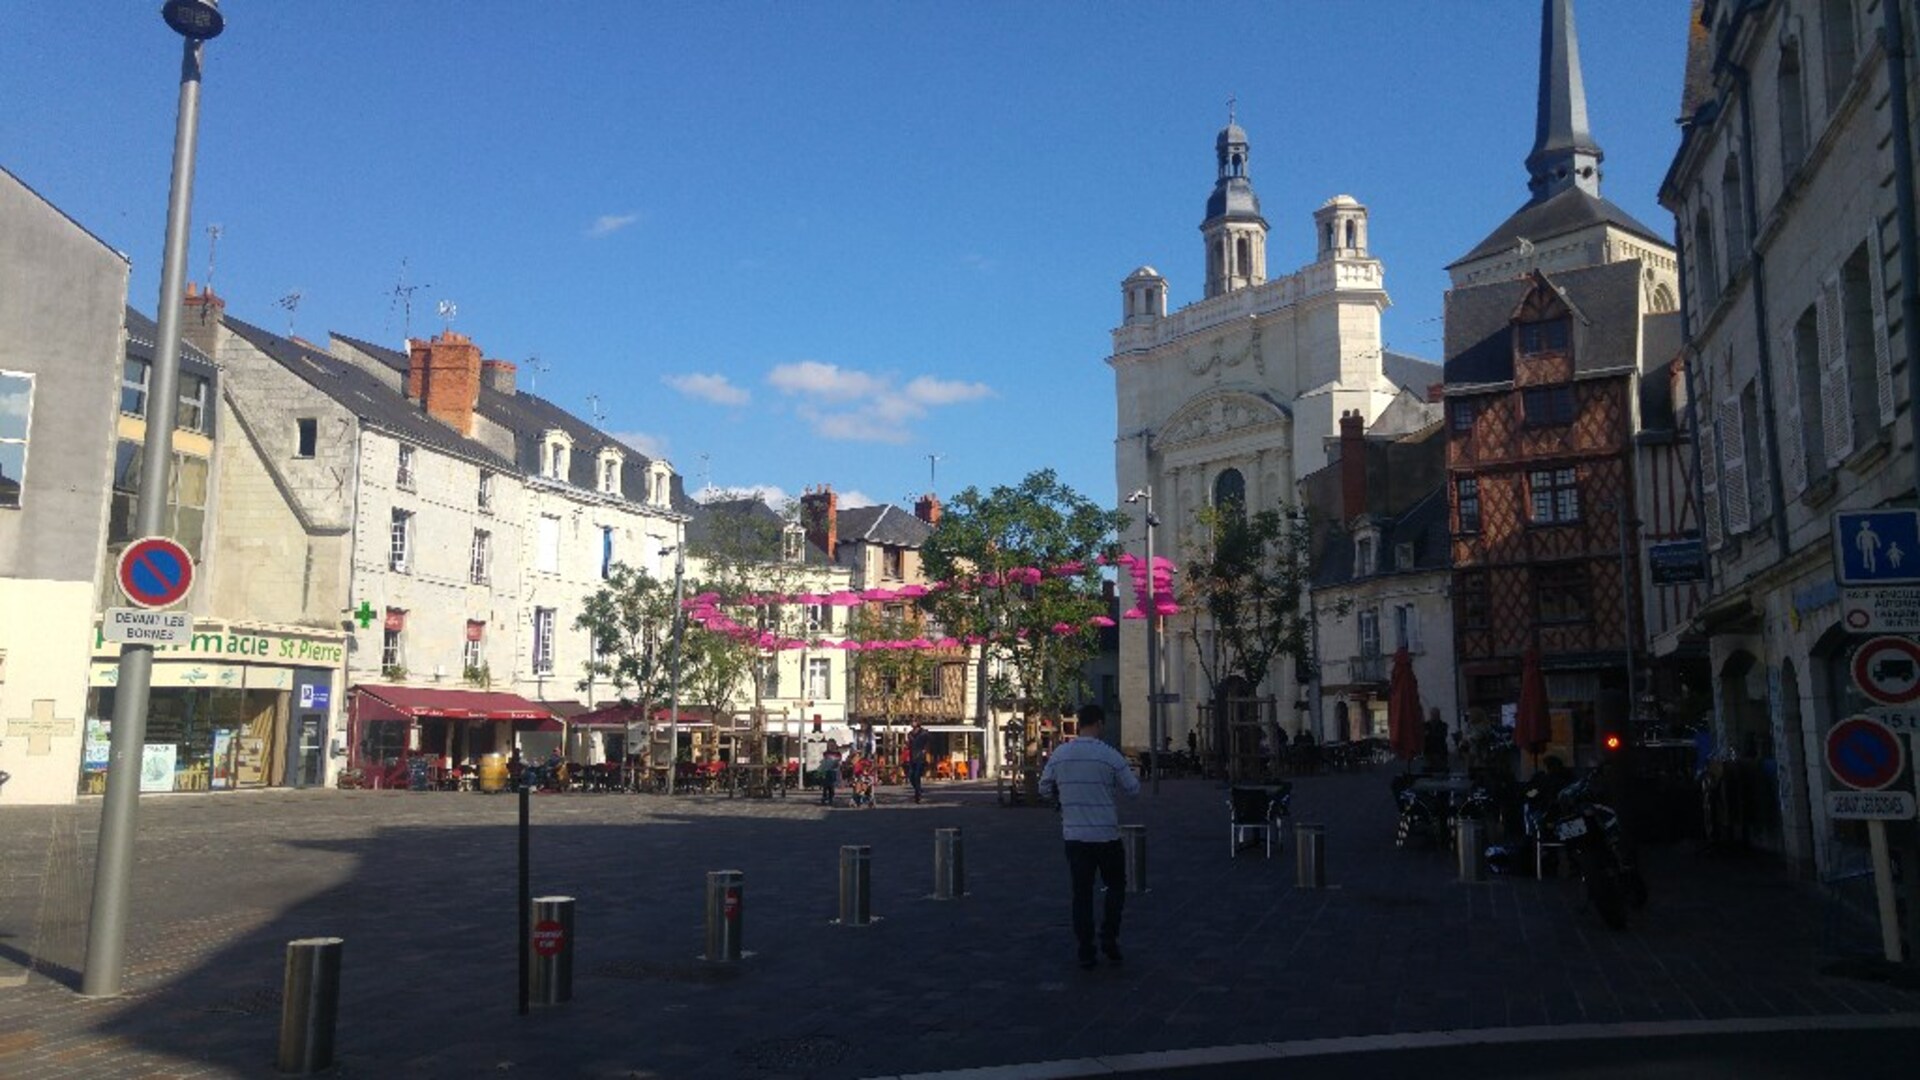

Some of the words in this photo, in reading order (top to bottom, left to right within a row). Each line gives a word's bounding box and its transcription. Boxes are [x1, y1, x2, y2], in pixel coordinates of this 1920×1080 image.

[115, 612, 161, 625] DEVANT
[164, 616, 185, 627] LES
[126, 628, 175, 640] BORNES
[94, 625, 269, 656] macie
[279, 637, 295, 659] St
[298, 638, 342, 663] Pierre
